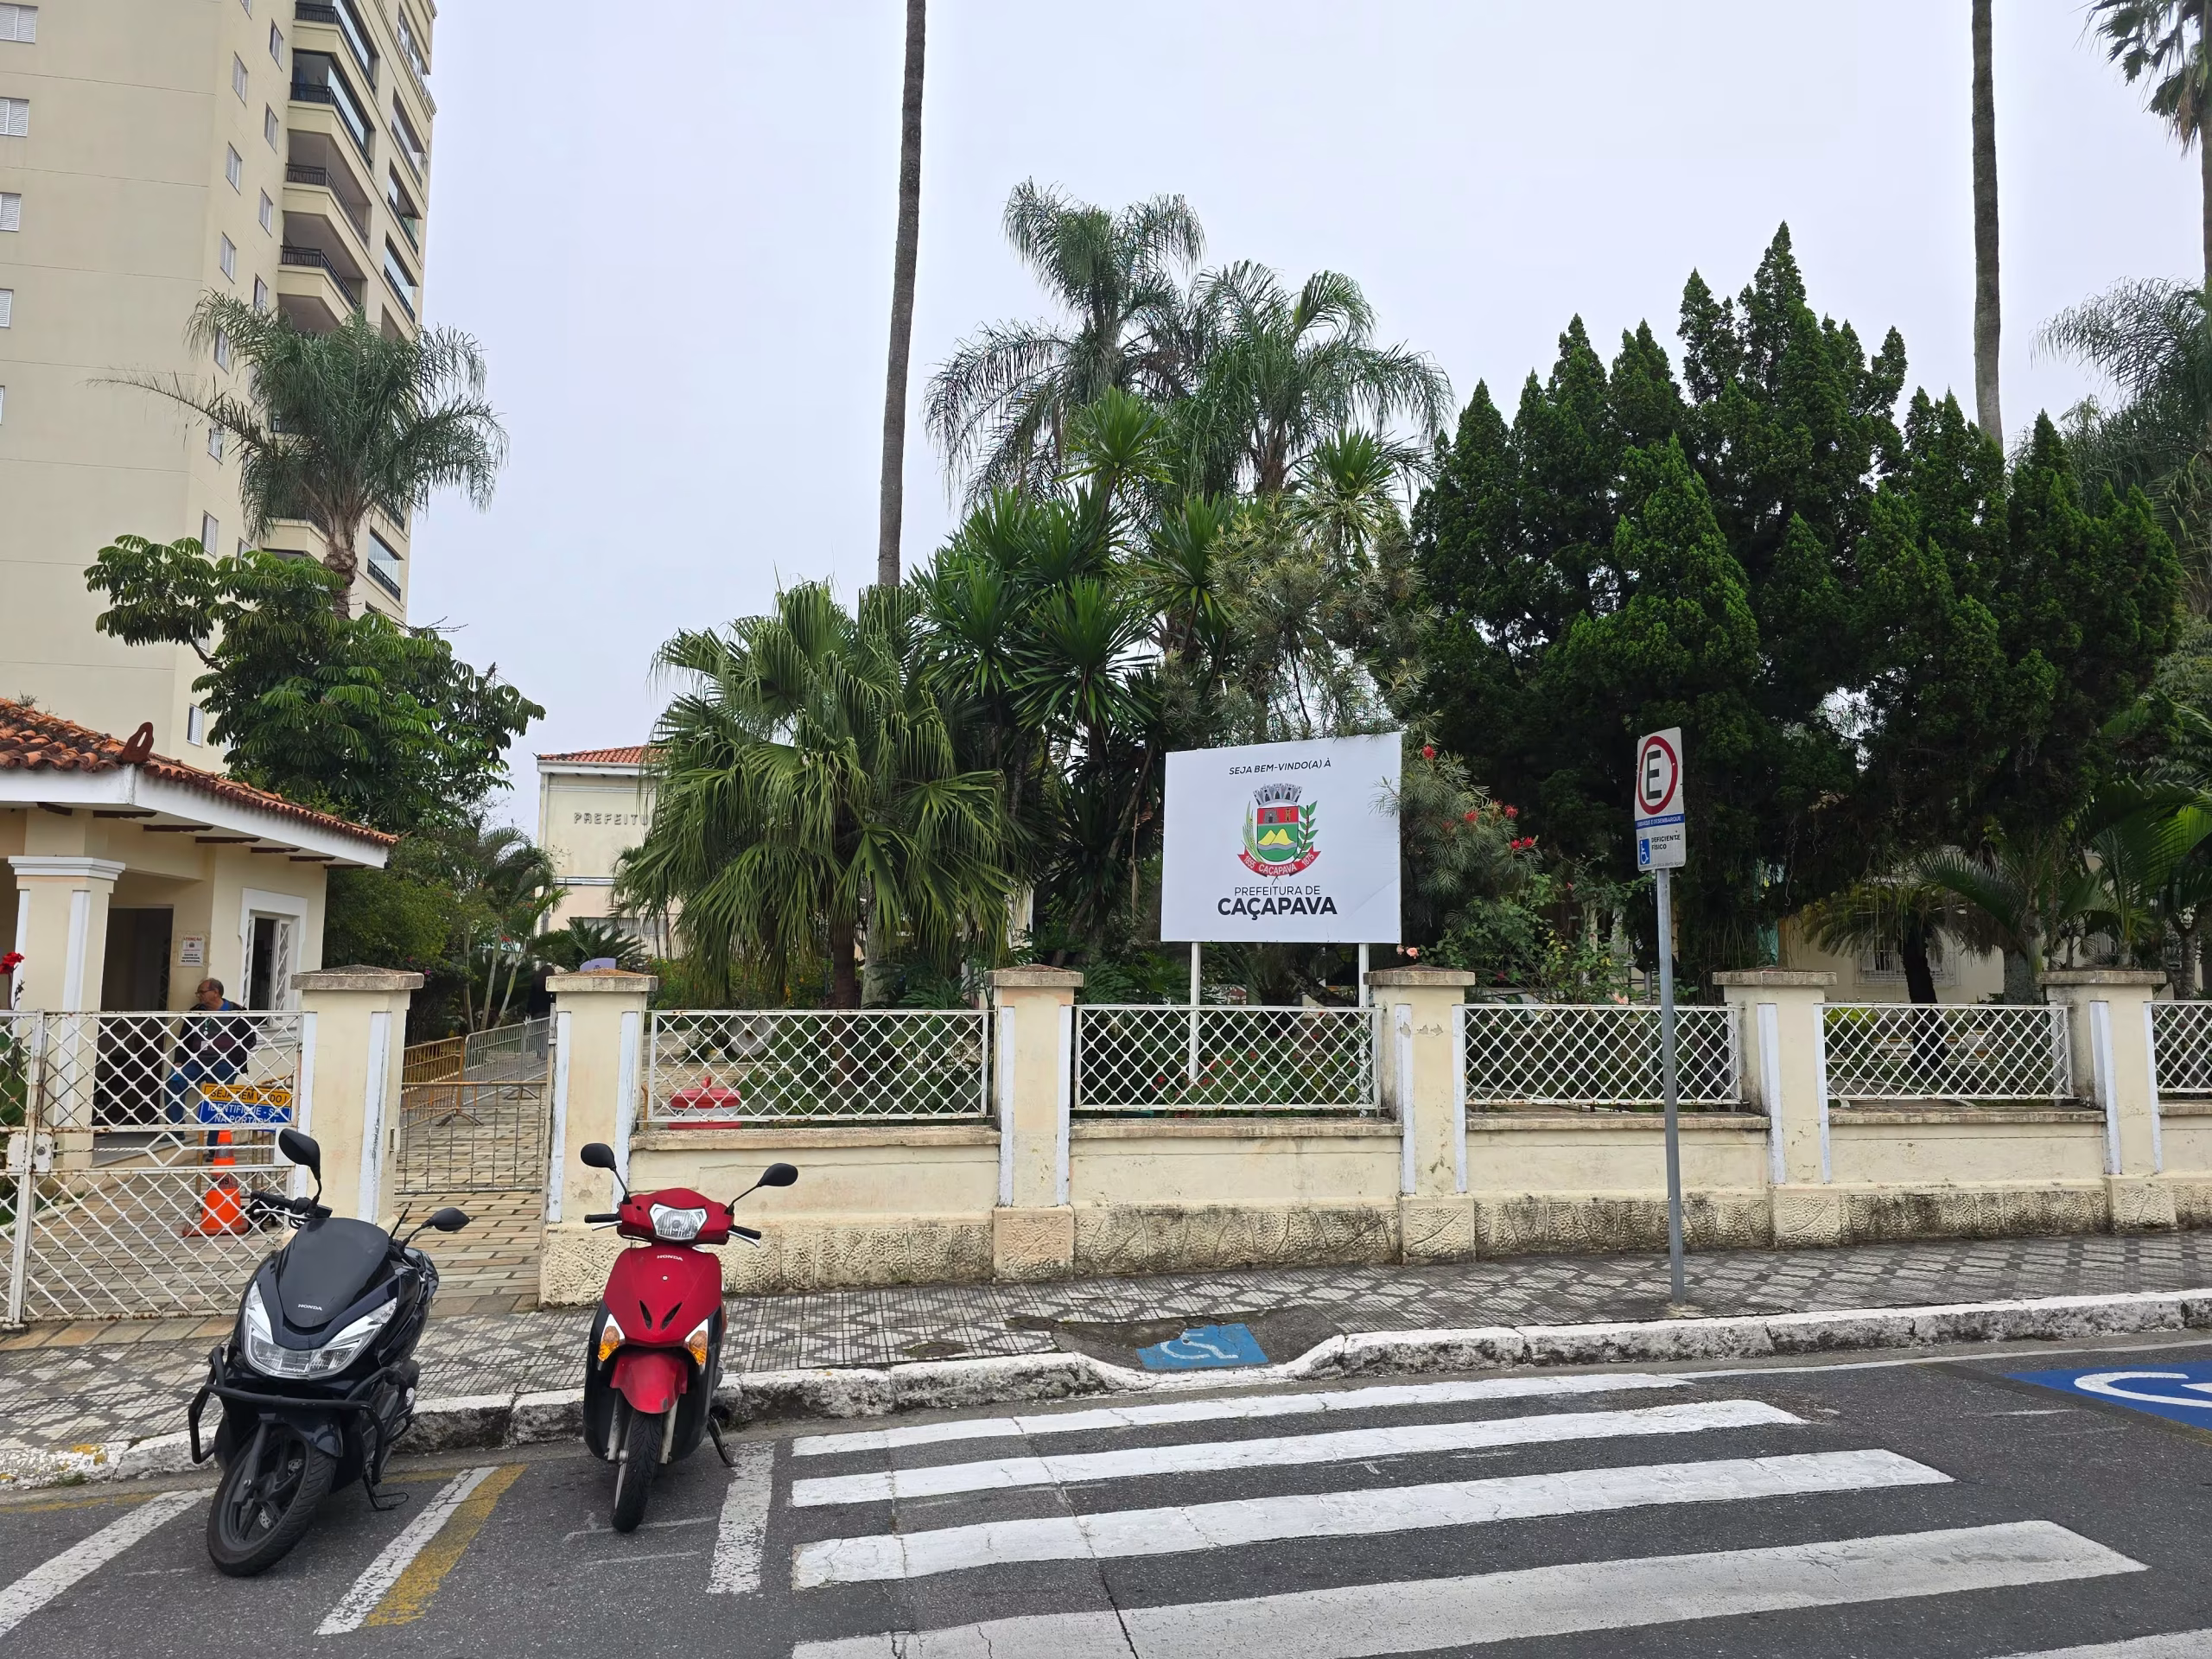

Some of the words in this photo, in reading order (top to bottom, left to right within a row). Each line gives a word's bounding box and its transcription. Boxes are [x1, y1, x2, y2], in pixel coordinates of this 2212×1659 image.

[1229, 766, 1252, 775] SEJA
[1254, 760, 1323, 773] BEM-VINDO(A)
[1646, 750, 1662, 800] E
[574, 812, 649, 826] PREFEITU
[1651, 834, 1681, 843] DEFICIENTE
[1243, 855, 1256, 868] 1855
[1301, 853, 1314, 867] 1875
[1234, 886, 1303, 896] PREFEITURA
[1305, 886, 1321, 895] DE
[1217, 896, 1338, 920] CAÇAPAVA
[297, 1303, 323, 1312] HONDA
